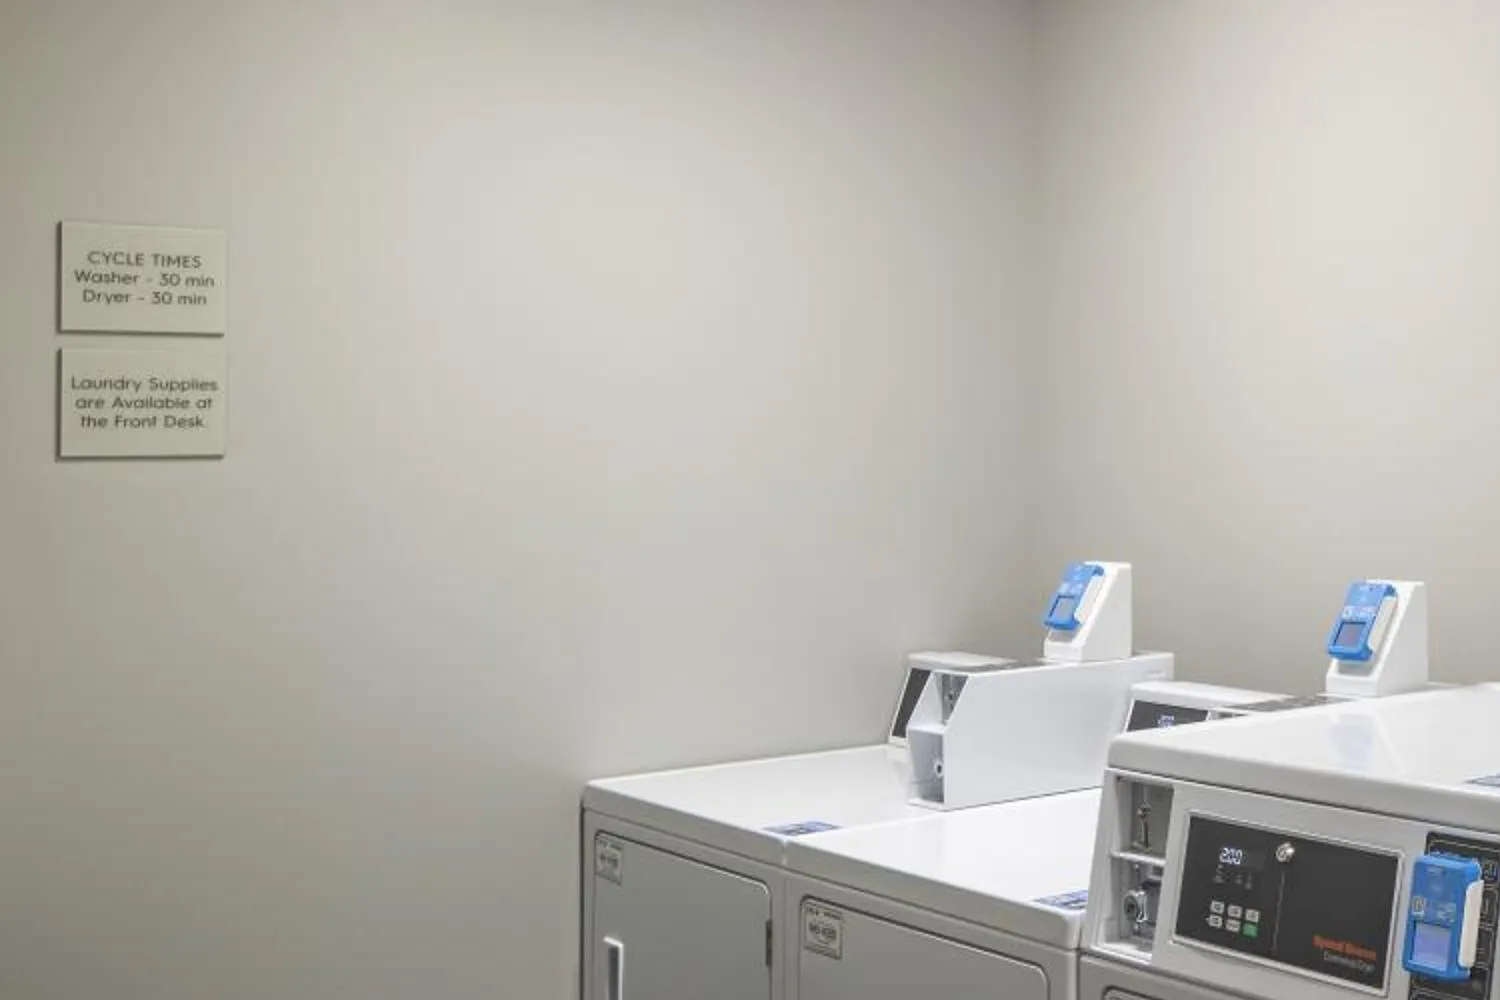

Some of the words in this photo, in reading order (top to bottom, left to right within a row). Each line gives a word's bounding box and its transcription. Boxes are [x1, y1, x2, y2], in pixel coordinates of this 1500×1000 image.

[88, 251, 144, 267] CYCLE
[151, 254, 202, 269] TIMES
[74, 269, 140, 285] Washer
[159, 272, 181, 287] 30
[185, 274, 215, 287] min
[82, 289, 132, 304] Dryer
[151, 291, 173, 305] 30
[177, 293, 208, 305] min
[71, 376, 142, 392] Laundry
[150, 377, 219, 392] Supplies
[75, 398, 105, 409] are
[112, 396, 190, 409] Available
[196, 398, 212, 409] at
[80, 415, 108, 428] the
[115, 415, 156, 428] Front
